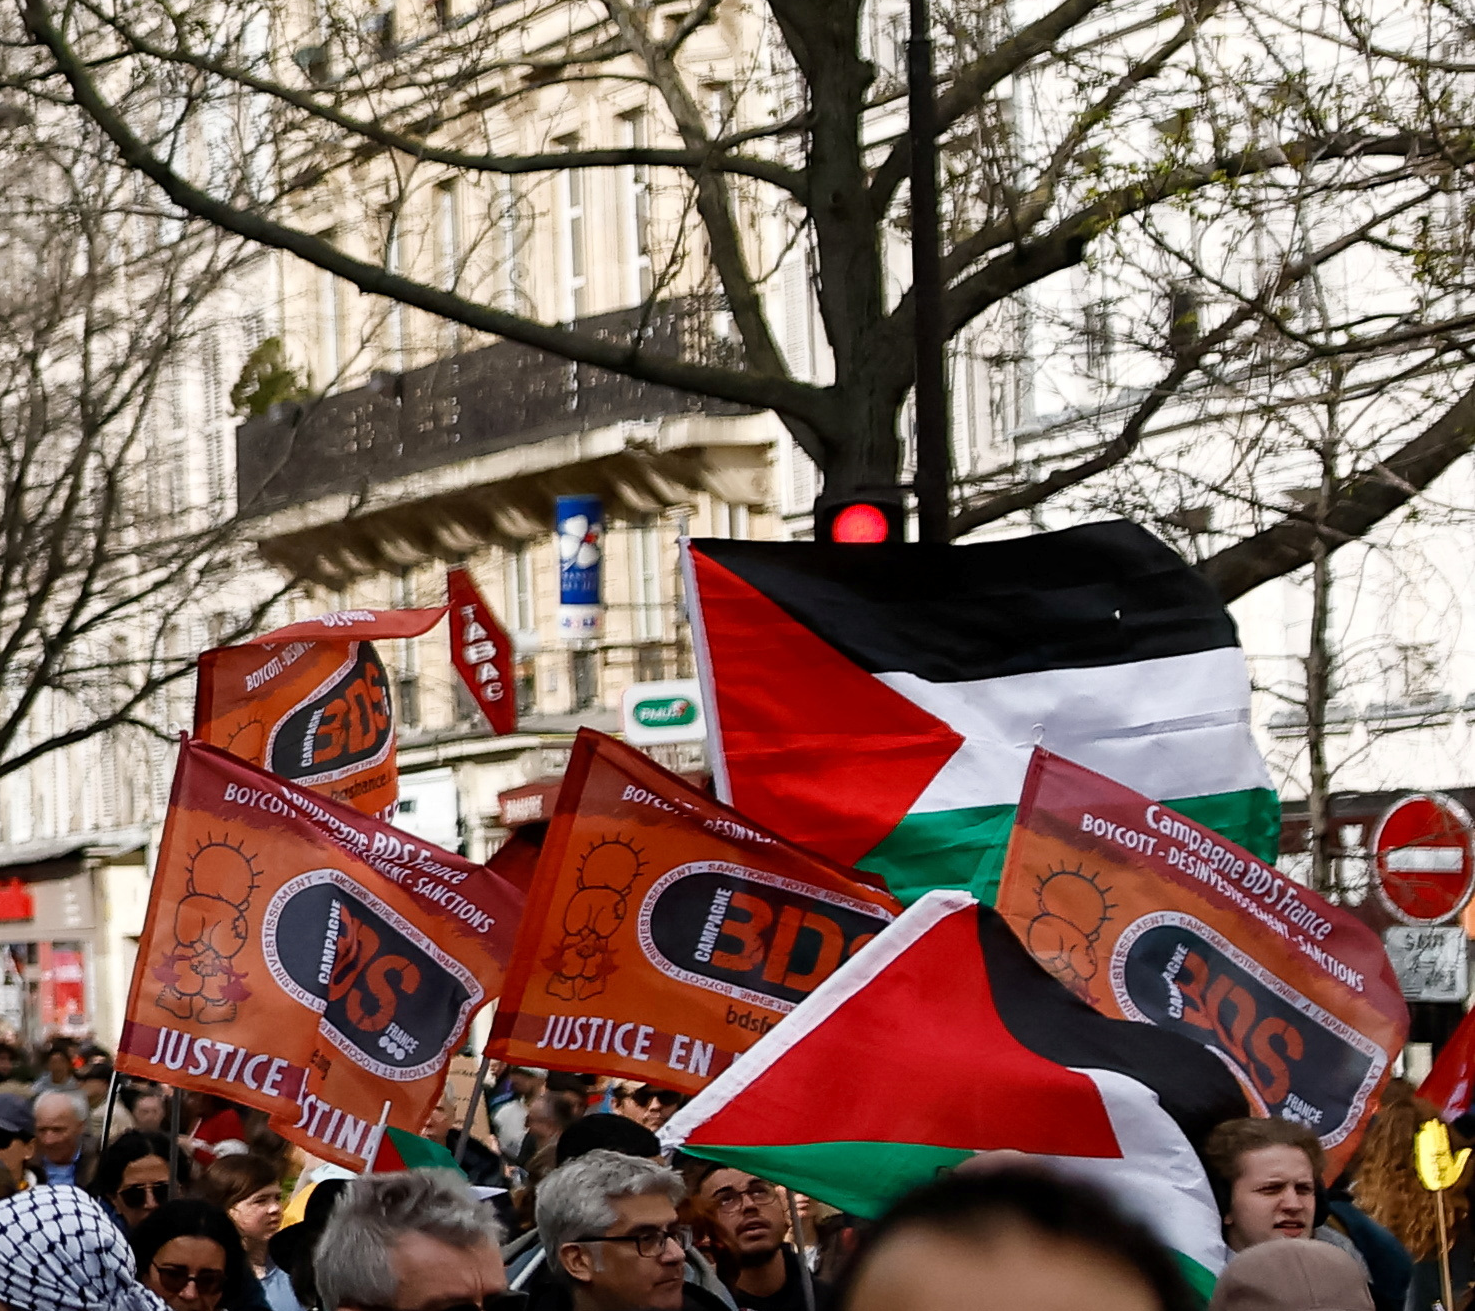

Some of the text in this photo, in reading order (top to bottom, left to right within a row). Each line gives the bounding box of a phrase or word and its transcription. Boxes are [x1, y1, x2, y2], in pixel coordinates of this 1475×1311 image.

[459, 603, 504, 702] TABAC
[371, 831, 417, 864] BDS
[1081, 813, 1158, 857] BOYCOTT
[413, 877, 496, 934] SANCTIONS
[1145, 804, 1333, 942] Campagne BDS France
[318, 899, 342, 985] CAMPAGNE
[694, 887, 733, 964] CAMPAGNE
[150, 1027, 290, 1095] JUSTICE
[385, 1021, 421, 1054] FRANCE
[537, 1015, 715, 1077] JUSTICE EN
